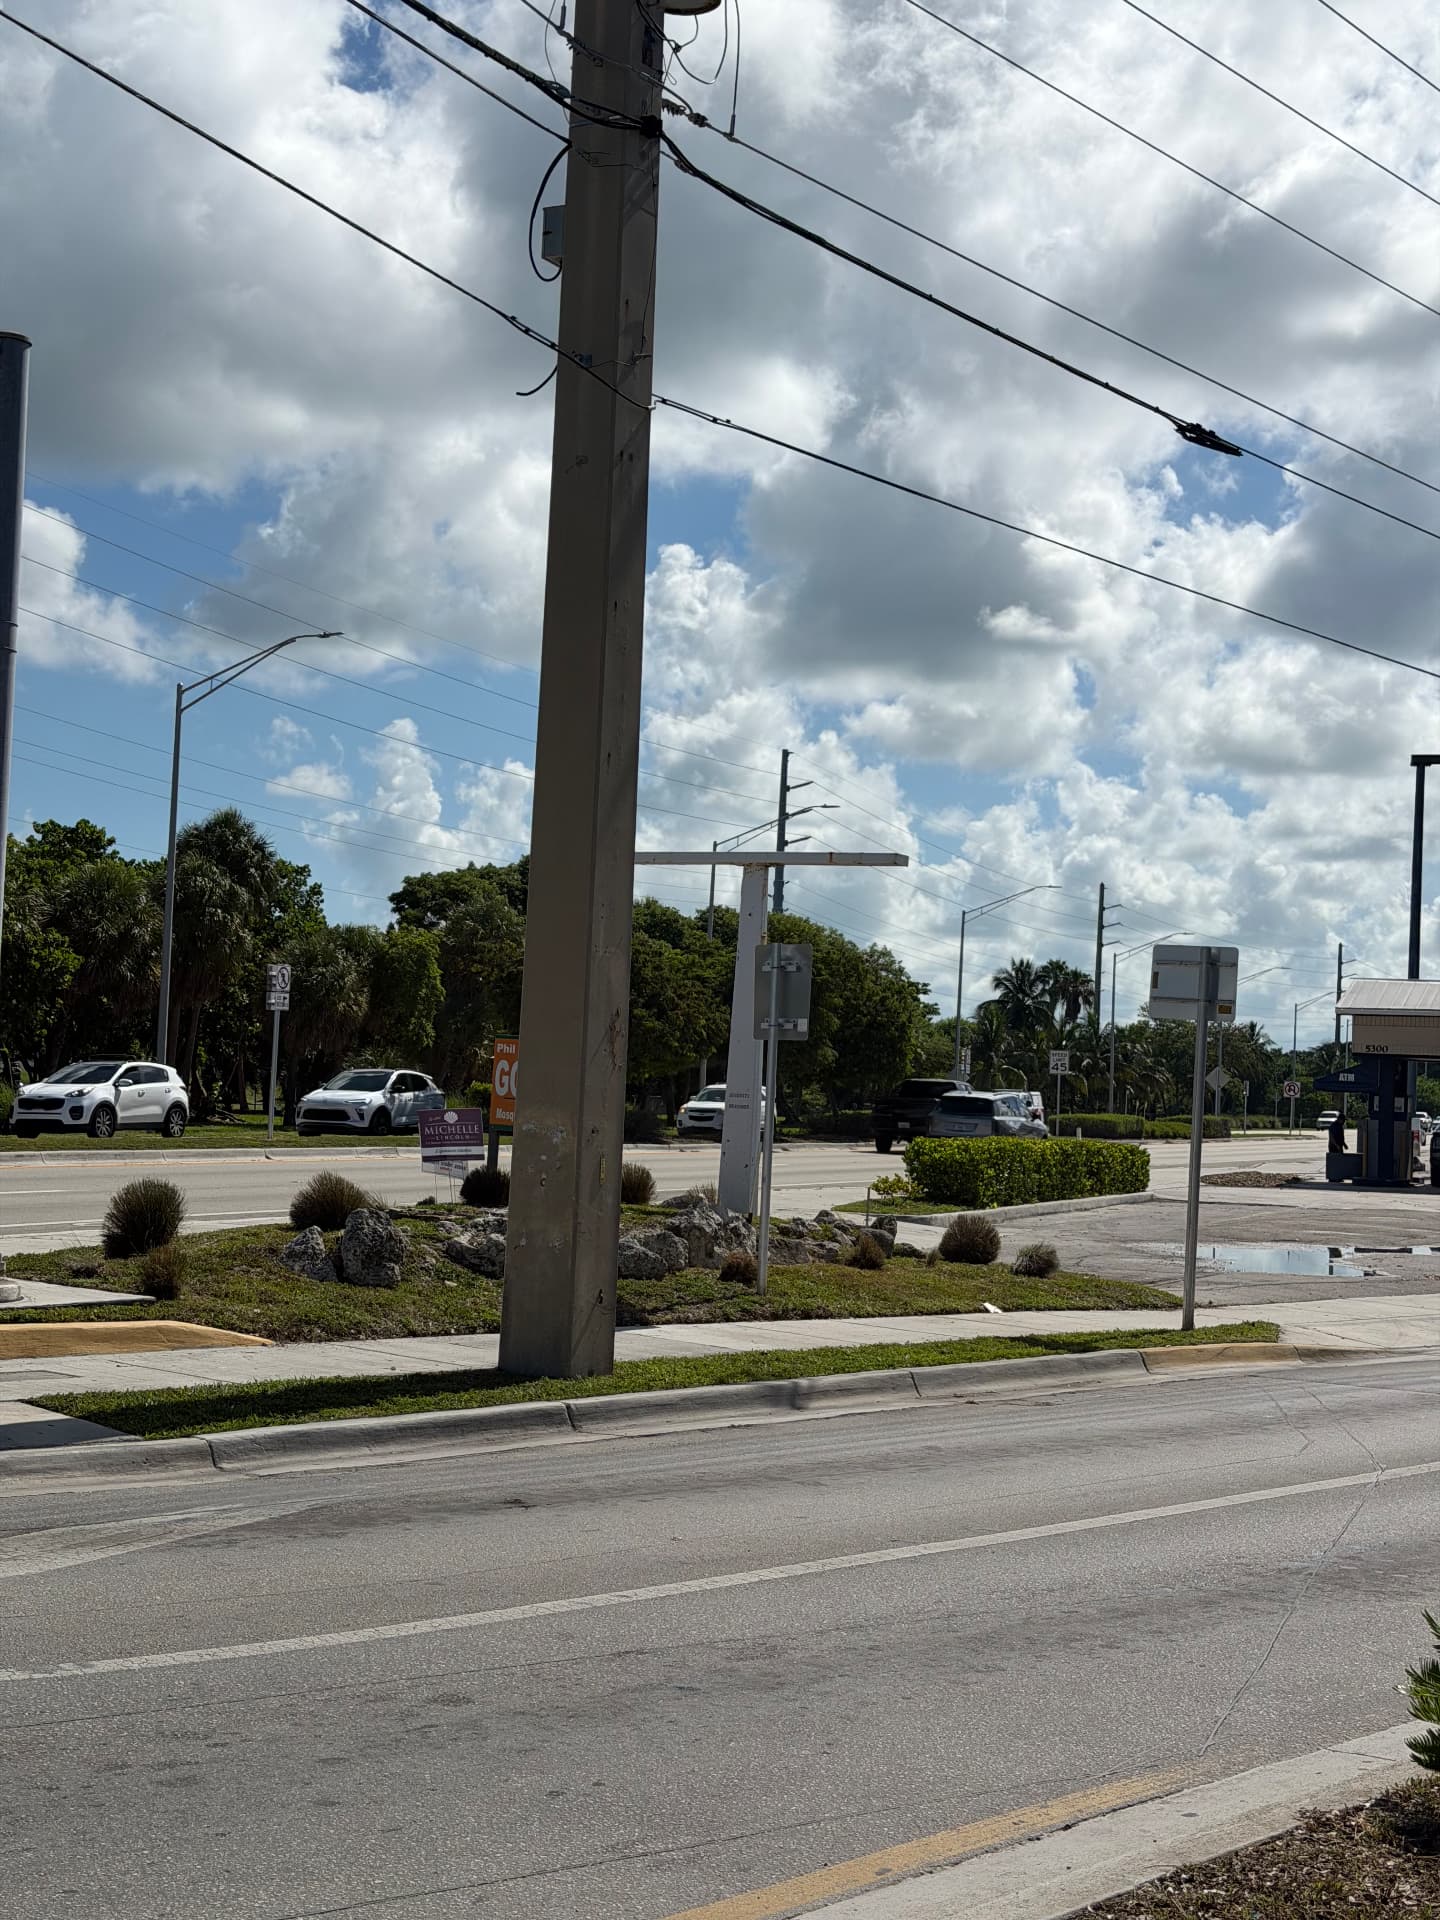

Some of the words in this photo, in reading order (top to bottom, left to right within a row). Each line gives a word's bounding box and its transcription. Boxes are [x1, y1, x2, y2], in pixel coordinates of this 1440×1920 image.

[496, 1043, 515, 1054] Phil
[1365, 1044, 1389, 1053] 5300
[1051, 1063, 1067, 1071] 45
[1339, 1072, 1355, 1082] ATM
[424, 1124, 480, 1135] MICHELLE
